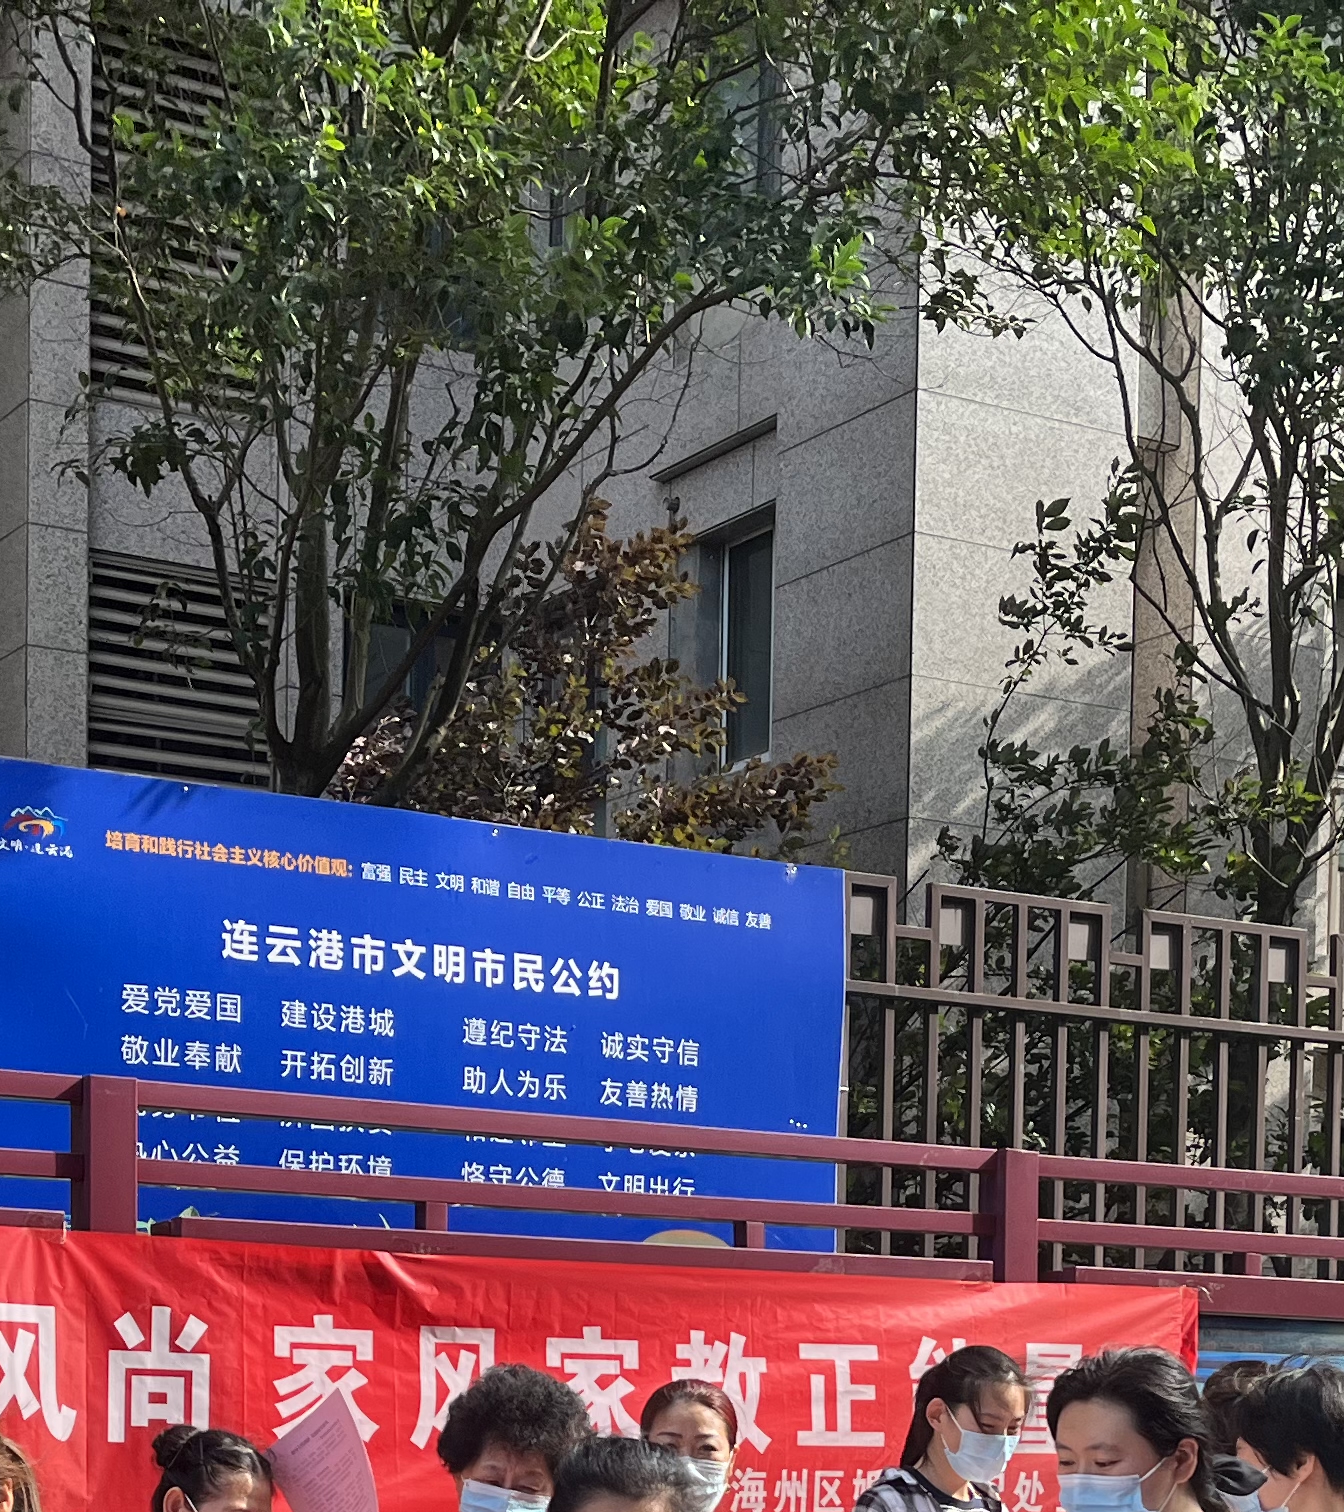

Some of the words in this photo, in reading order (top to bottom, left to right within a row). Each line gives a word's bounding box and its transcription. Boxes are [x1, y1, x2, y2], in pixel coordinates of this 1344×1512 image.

[361, 862, 392, 883] 富强
[399, 867, 429, 888] 民主
[435, 872, 464, 893] 文明
[471, 877, 500, 897] 和谐
[507, 882, 535, 902] 自由
[542, 886, 570, 906] 平等
[577, 891, 605, 910] 公正
[612, 895, 639, 915] 法治
[646, 899, 673, 919] 爱国
[679, 903, 706, 923] 敬业
[712, 907, 739, 927] 诚信
[745, 912, 772, 931] 友善
[221, 918, 621, 1001] 连云港市文明市民公约
[121, 983, 242, 1024] 爱党爱国
[281, 999, 395, 1037] 建设港城
[462, 1017, 568, 1055] 遵纪守法
[600, 1031, 700, 1067] 诚实守信
[120, 1034, 242, 1074] 敬业奉献
[280, 1050, 394, 1087] 开拓创新
[462, 1066, 568, 1101] 助人为乐
[599, 1077, 699, 1113] 友善热情
[279, 1148, 393, 1177] 保护环境
[461, 1161, 566, 1188] 恪守公德
[598, 1171, 696, 1197] 文明出行
